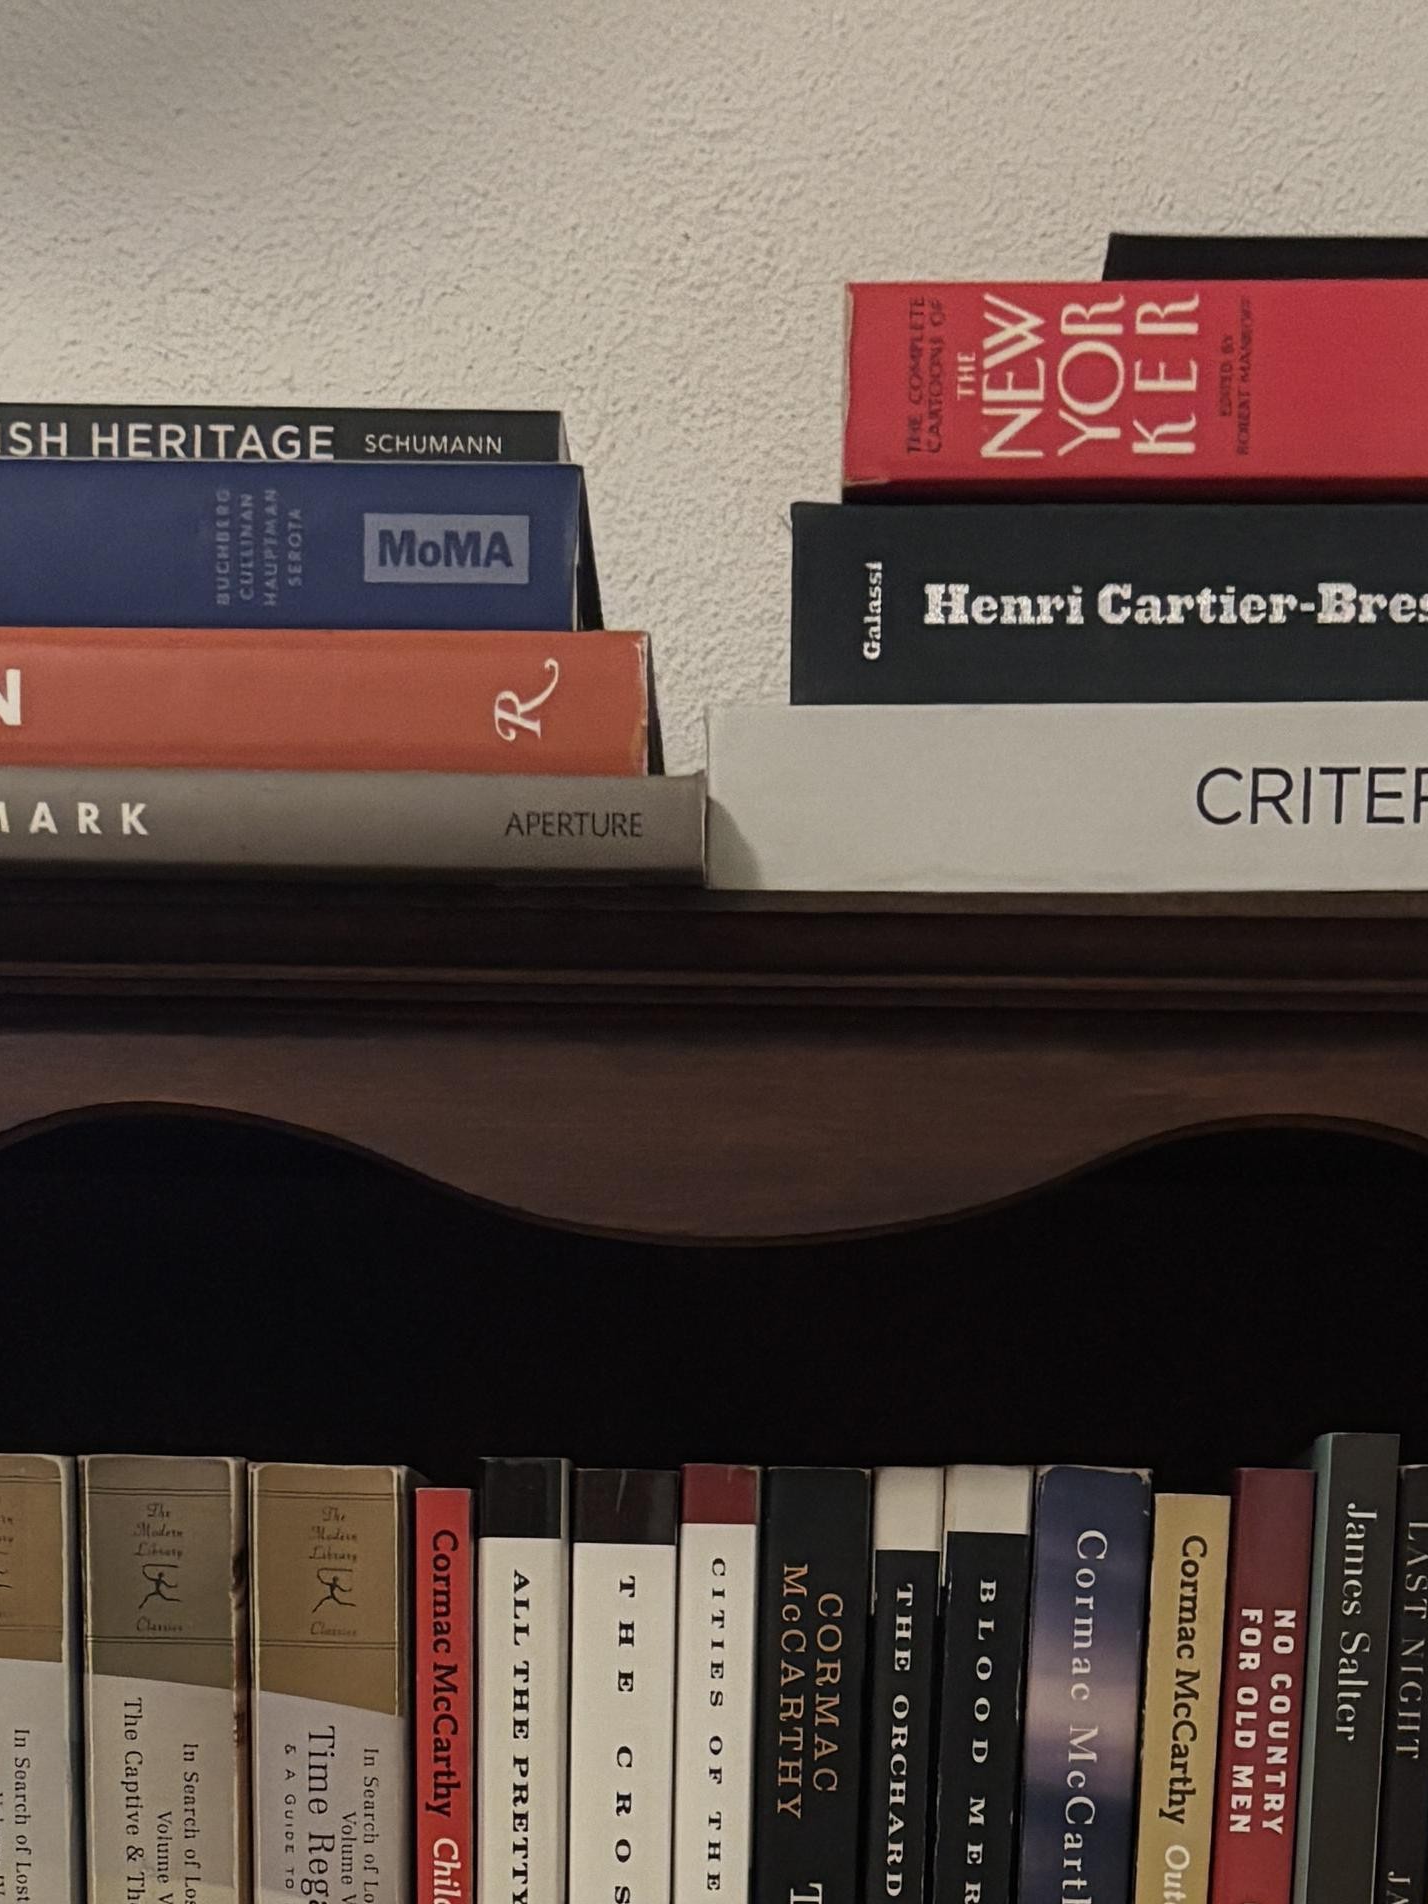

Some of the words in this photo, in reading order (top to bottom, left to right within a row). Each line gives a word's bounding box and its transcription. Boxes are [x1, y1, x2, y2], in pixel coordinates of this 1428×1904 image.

[906, 296, 925, 406] COMPLETE
[957, 351, 976, 400] THE
[980, 293, 1047, 459] NEW
[1057, 293, 1126, 457] YOR
[1132, 293, 1200, 456] KER
[926, 334, 943, 454] CARTOONS
[92, 424, 336, 461] HERITAGE
[364, 433, 503, 456] SCHUMANN
[906, 413, 924, 455] THE
[289, 506, 305, 587] SEROTA
[377, 529, 514, 570] MoMA
[862, 561, 884, 661] Galassi
[924, 583, 1085, 626] Henri
[504, 809, 645, 840] APERTURE
[431, 1530, 458, 1653] Cormac
[617, 1575, 636, 1693] THE
[1238, 1609, 1263, 1670] FOR
[1273, 1609, 1296, 1654] NO
[426, 1663, 461, 1817] McCarthy
[1233, 1687, 1258, 1749] OLD
[1261, 1673, 1292, 1835] COUNTRY
[1229, 1765, 1253, 1833] MEN
